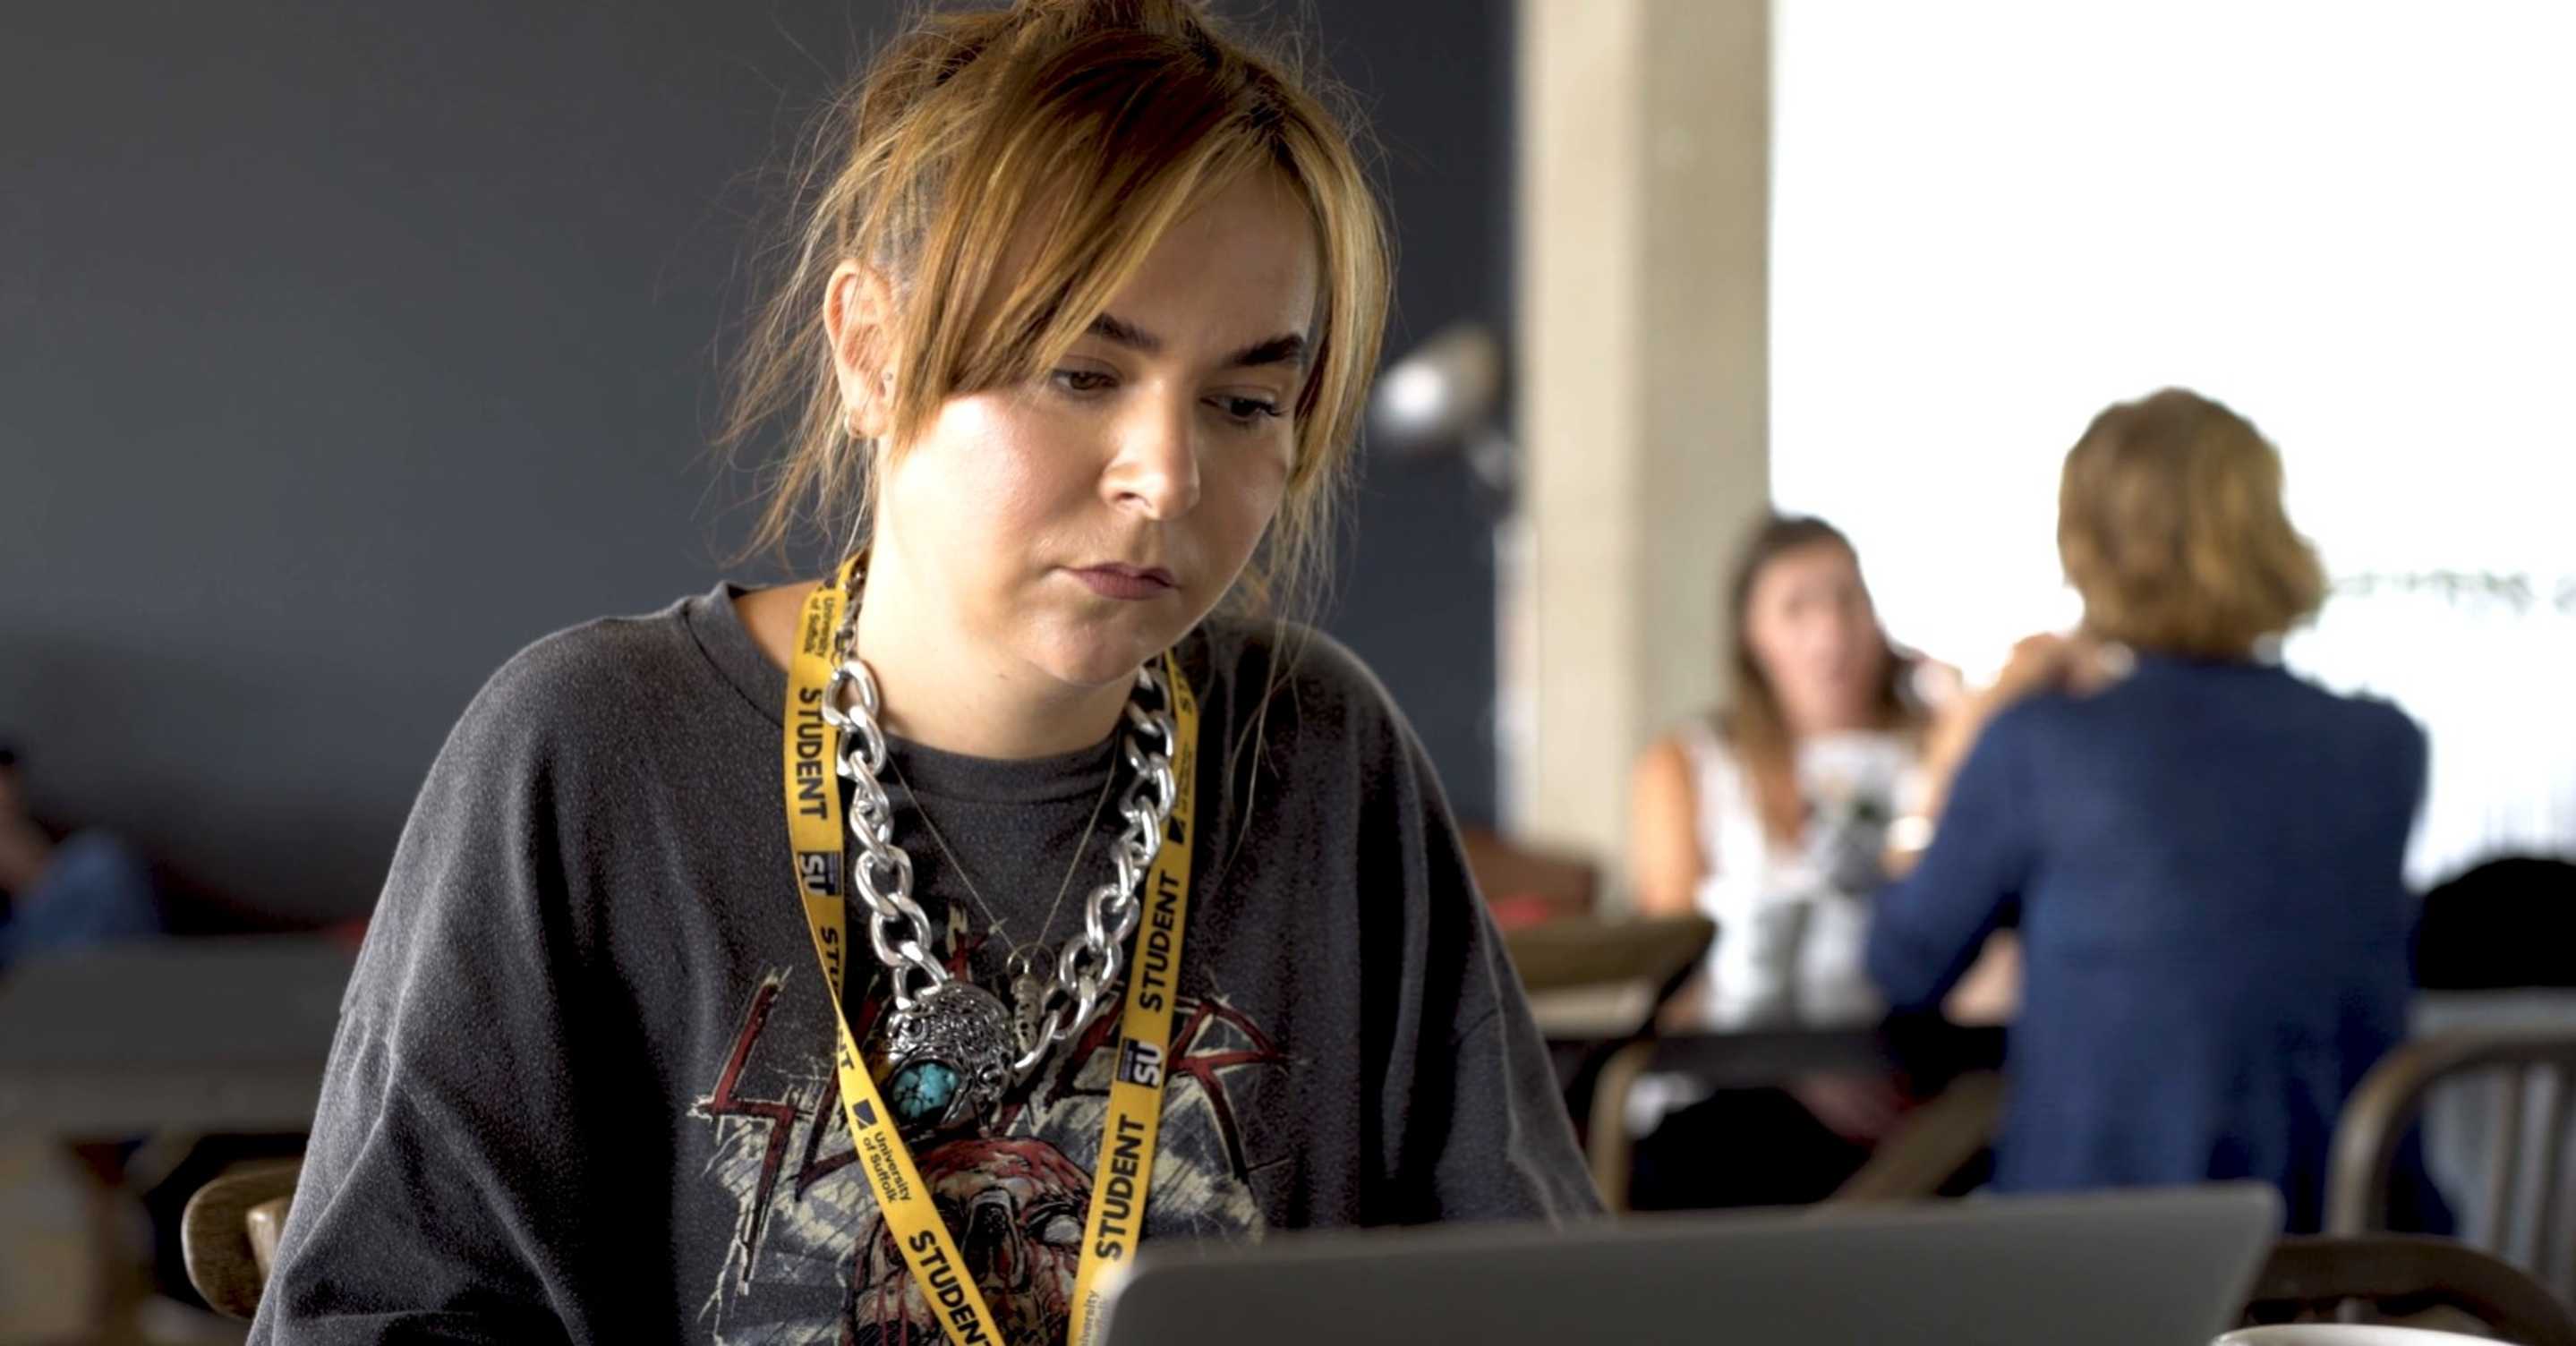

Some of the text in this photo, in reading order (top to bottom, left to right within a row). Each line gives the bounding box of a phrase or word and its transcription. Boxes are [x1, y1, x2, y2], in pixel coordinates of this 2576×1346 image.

[796, 686, 828, 820] STUDENT
[799, 854, 827, 898] SU
[1139, 868, 1179, 1014] STUDENT
[1132, 1040, 1163, 1086] SU
[862, 1137, 898, 1204] of Suffolk
[874, 1130, 912, 1201] University
[1095, 1113, 1145, 1261] STUDENT
[908, 1230, 993, 1346] STUDEN
